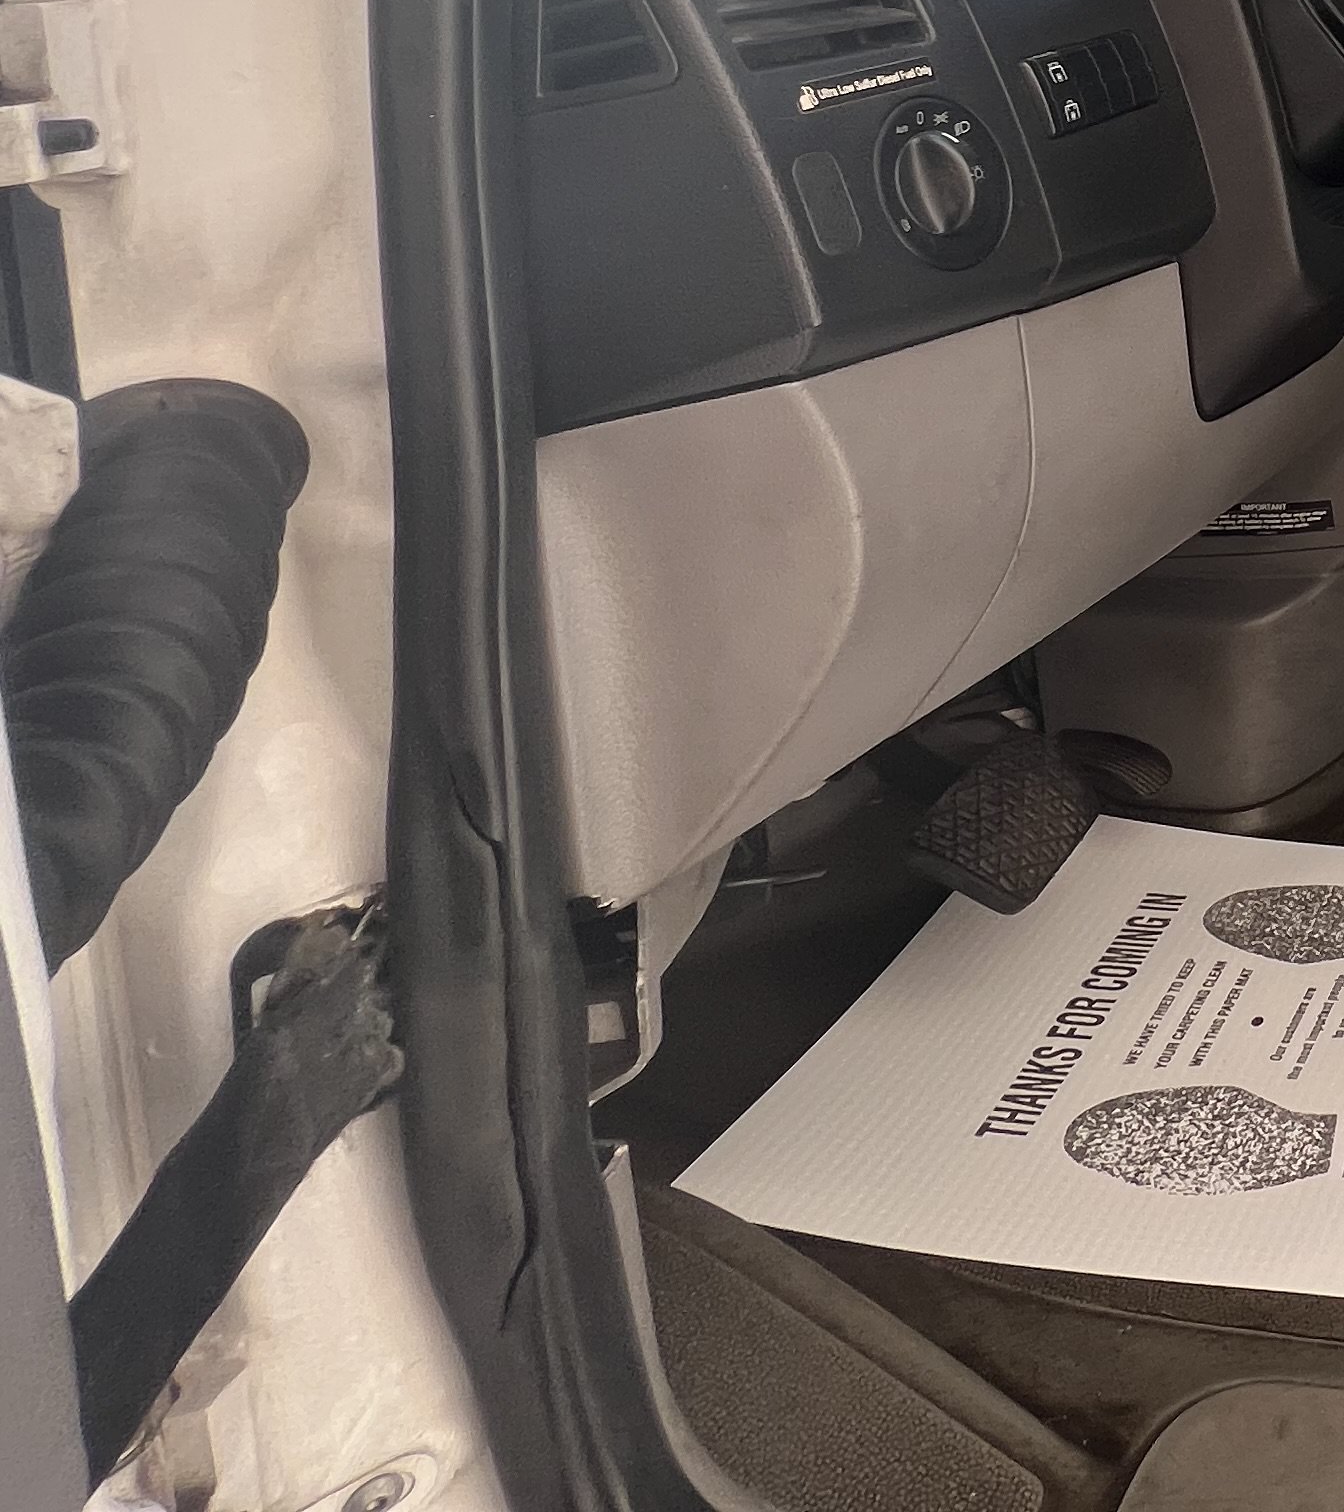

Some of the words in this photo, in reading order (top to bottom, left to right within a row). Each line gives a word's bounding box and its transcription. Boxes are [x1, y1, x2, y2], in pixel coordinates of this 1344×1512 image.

[817, 87, 839, 100] Ultra
[837, 84, 855, 96] Low
[876, 72, 900, 86] Diesel
[899, 68, 916, 81] Fuel
[915, 64, 933, 78] Only
[1240, 502, 1287, 511] IMPORTANT
[1136, 892, 1187, 912] IN
[1081, 916, 1172, 991] COMING
[1175, 958, 1196, 980] KEEP
[1167, 981, 1184, 993] TO
[1046, 996, 1117, 1040] FOR
[1150, 994, 1175, 1021] TRIED
[1154, 1042, 1180, 1069] YOUR
[1172, 989, 1211, 1040] CARPETING
[1202, 960, 1227, 988] CLEAN
[1188, 1041, 1213, 1067] WITH
[1203, 1018, 1225, 1040] THIS
[1217, 988, 1243, 1017] PAPER
[1235, 968, 1253, 987] MAT
[1134, 1022, 1159, 1048] HAVE
[1122, 1049, 1143, 1065] WE
[1270, 1045, 1287, 1061] Our
[974, 1046, 1083, 1138] THANKS
